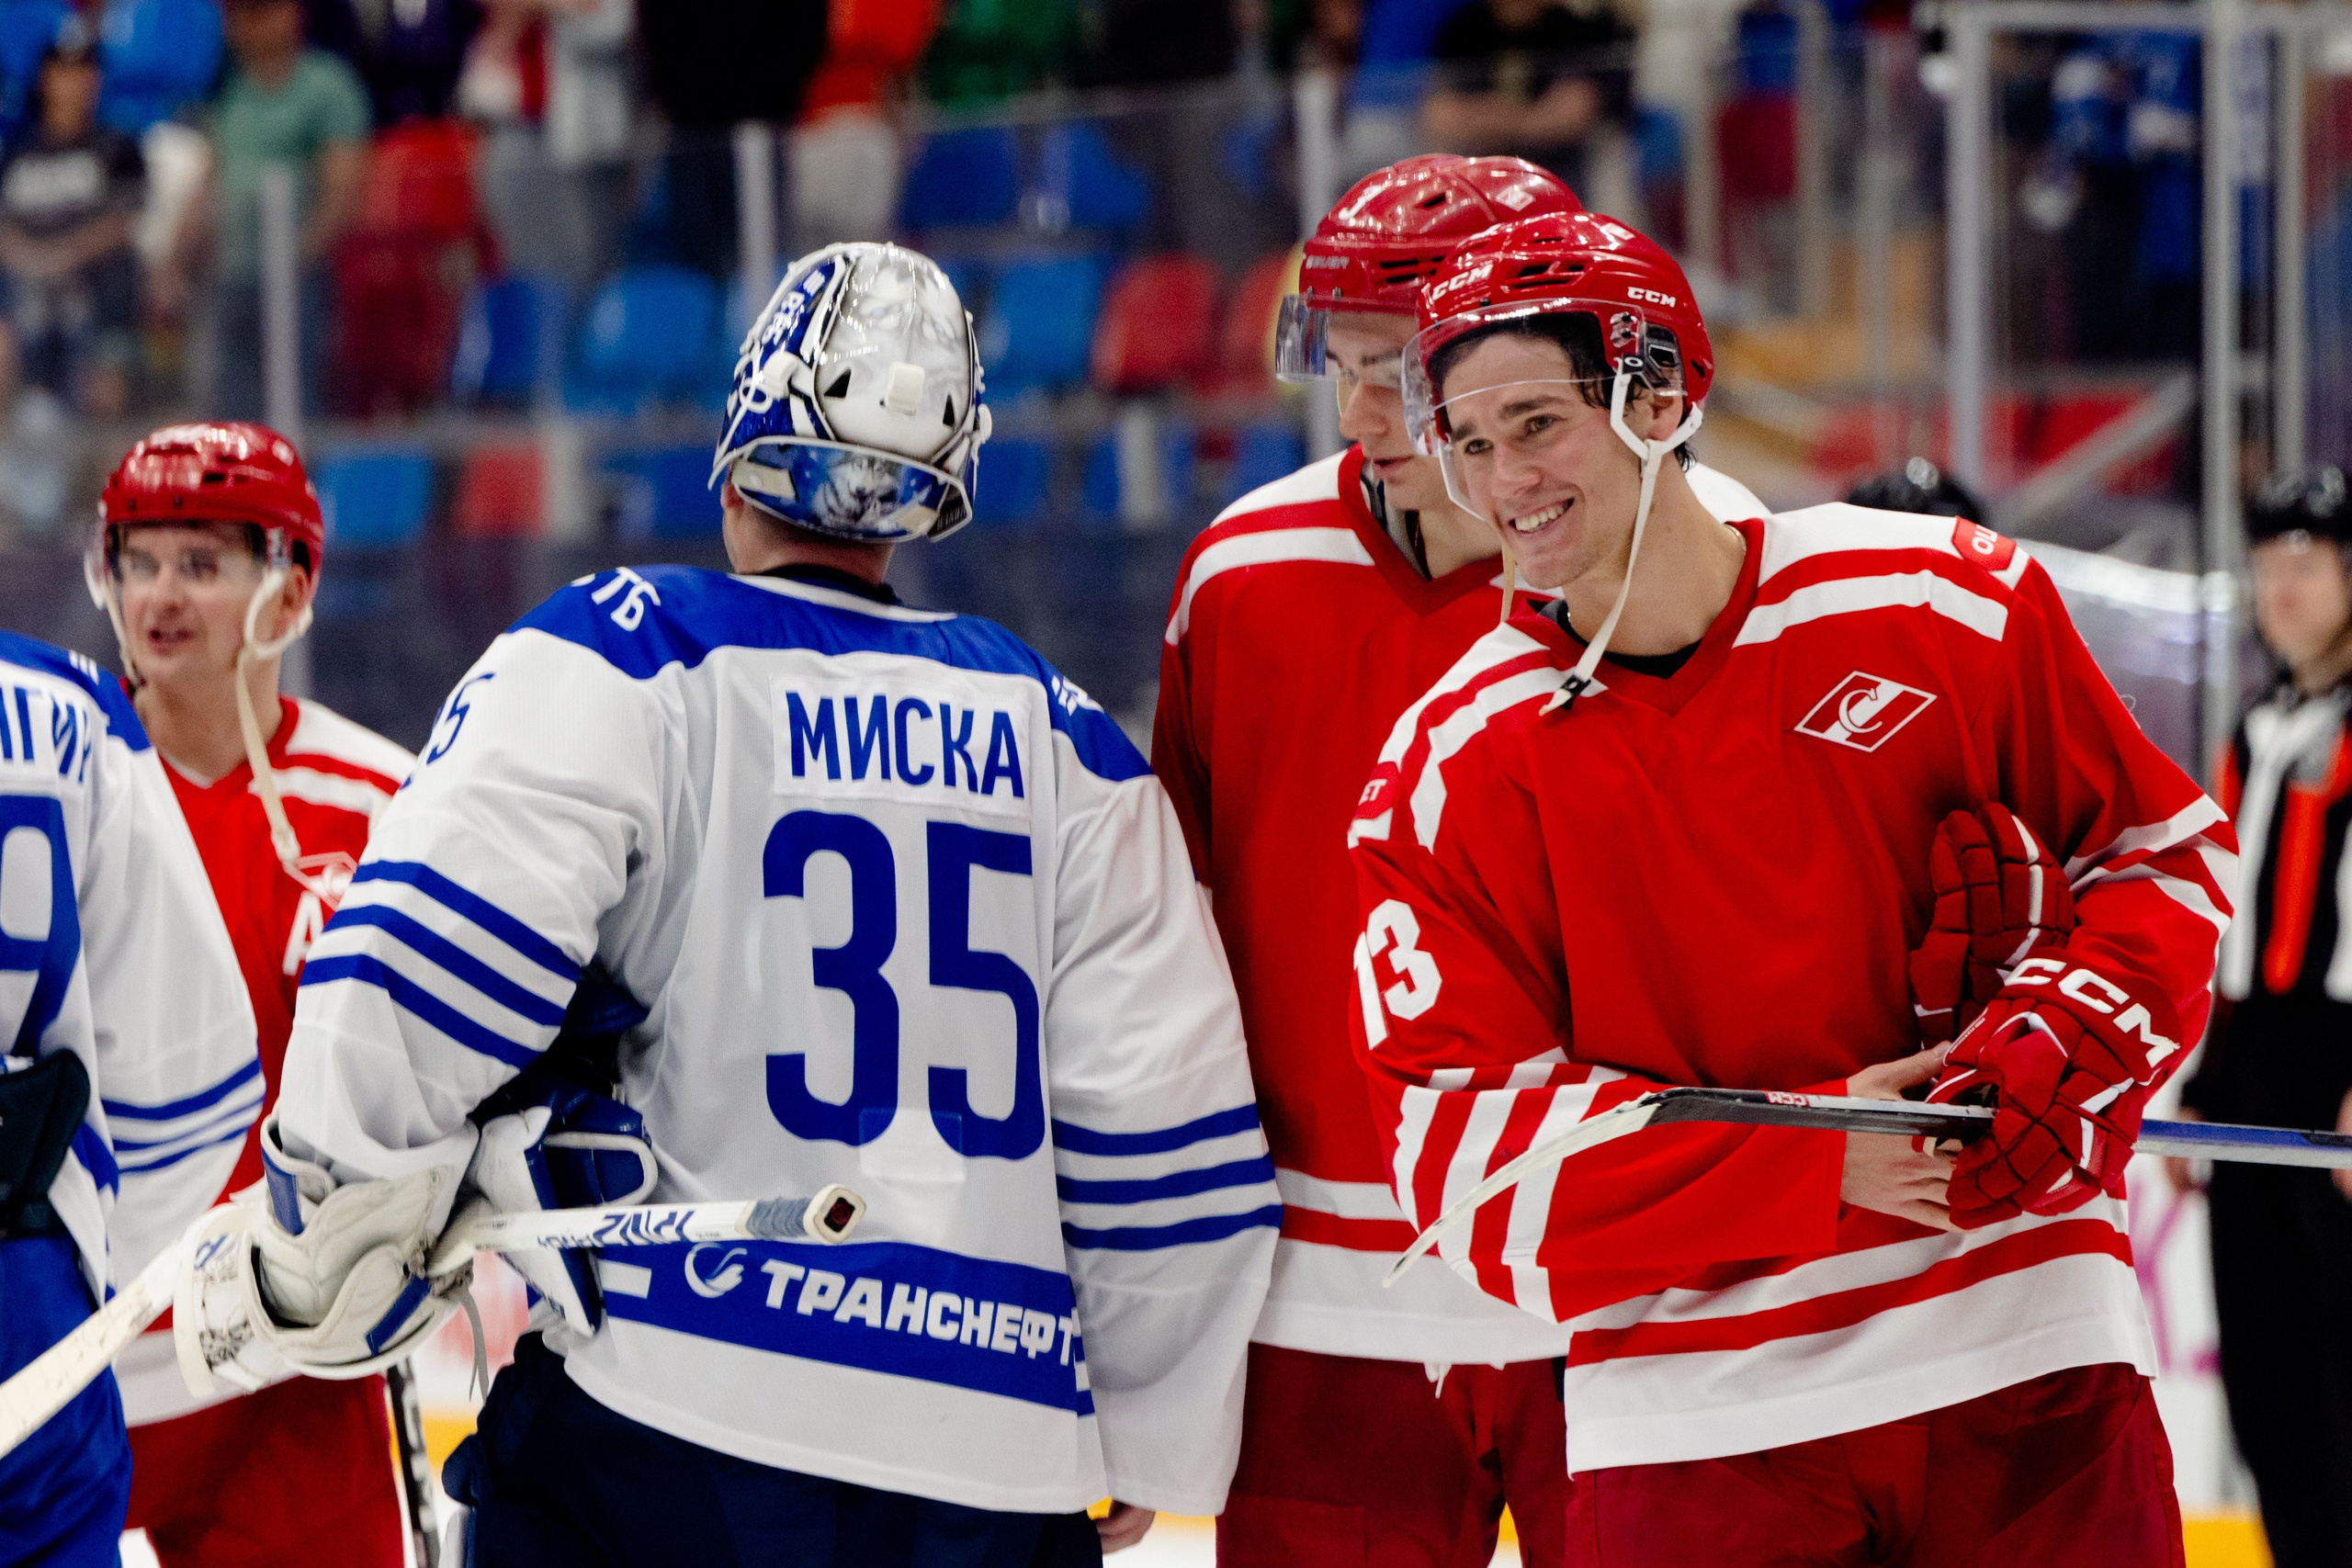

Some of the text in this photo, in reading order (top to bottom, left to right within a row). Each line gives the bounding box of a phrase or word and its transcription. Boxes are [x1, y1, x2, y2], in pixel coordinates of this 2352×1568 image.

[1432, 264, 1495, 301] CCM
[1626, 286, 1677, 309] CCM
[570, 566, 662, 632] ТБ
[786, 689, 1025, 799] МИСКА
[763, 810, 1046, 1160] 35
[1353, 898, 1442, 1051] 13
[2004, 957, 2181, 1068] CCM
[1767, 1090, 1807, 1107] CCM
